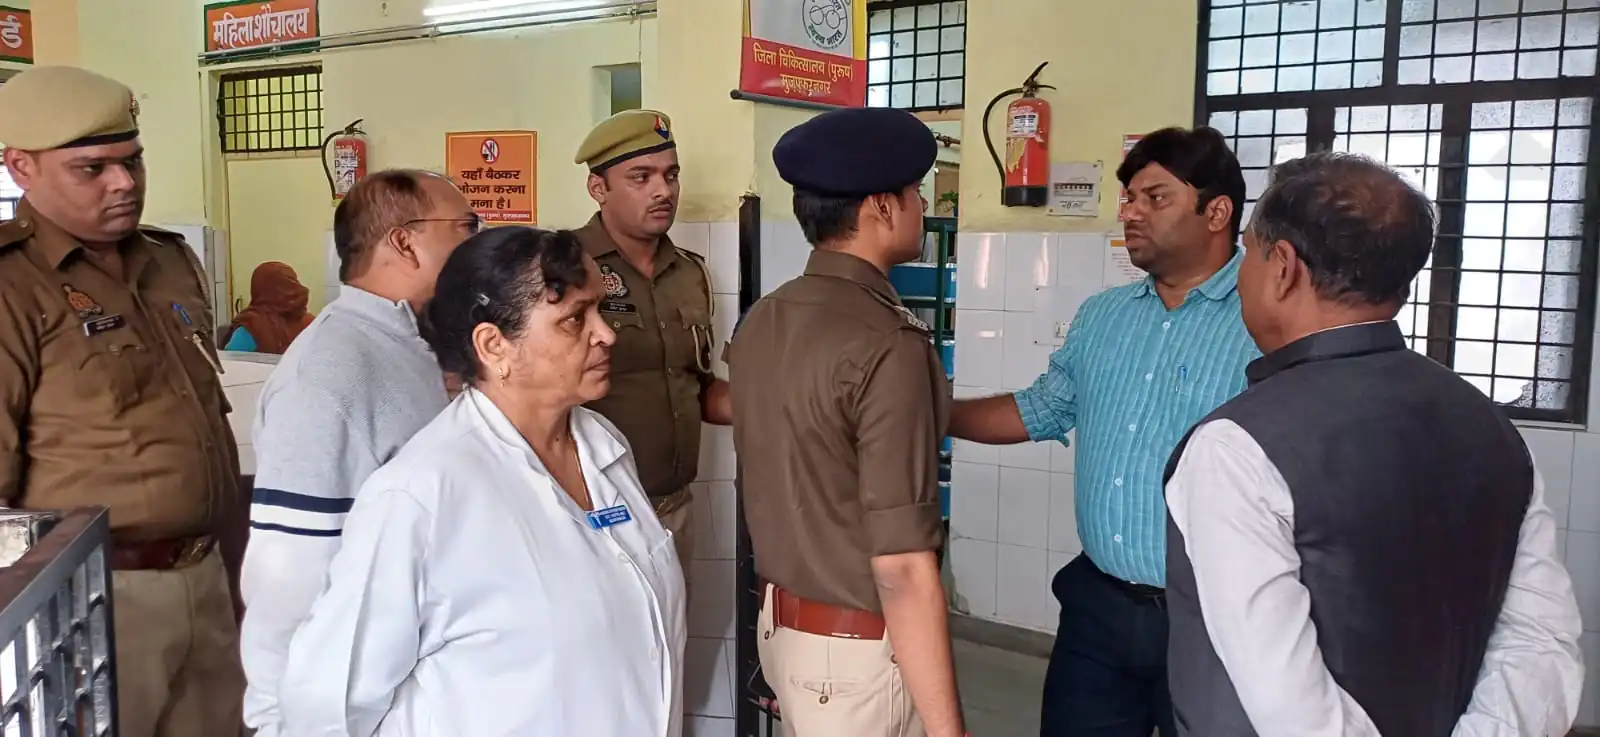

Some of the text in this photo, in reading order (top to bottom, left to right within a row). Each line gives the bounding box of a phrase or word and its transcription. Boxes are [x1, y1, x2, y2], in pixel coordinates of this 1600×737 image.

[753, 42, 777, 65] जिला
[779, 47, 826, 75] चिकित्सालय
[485, 167, 520, 180] बैठकर
[493, 184, 526, 194] करना
[470, 199, 493, 208] मना
